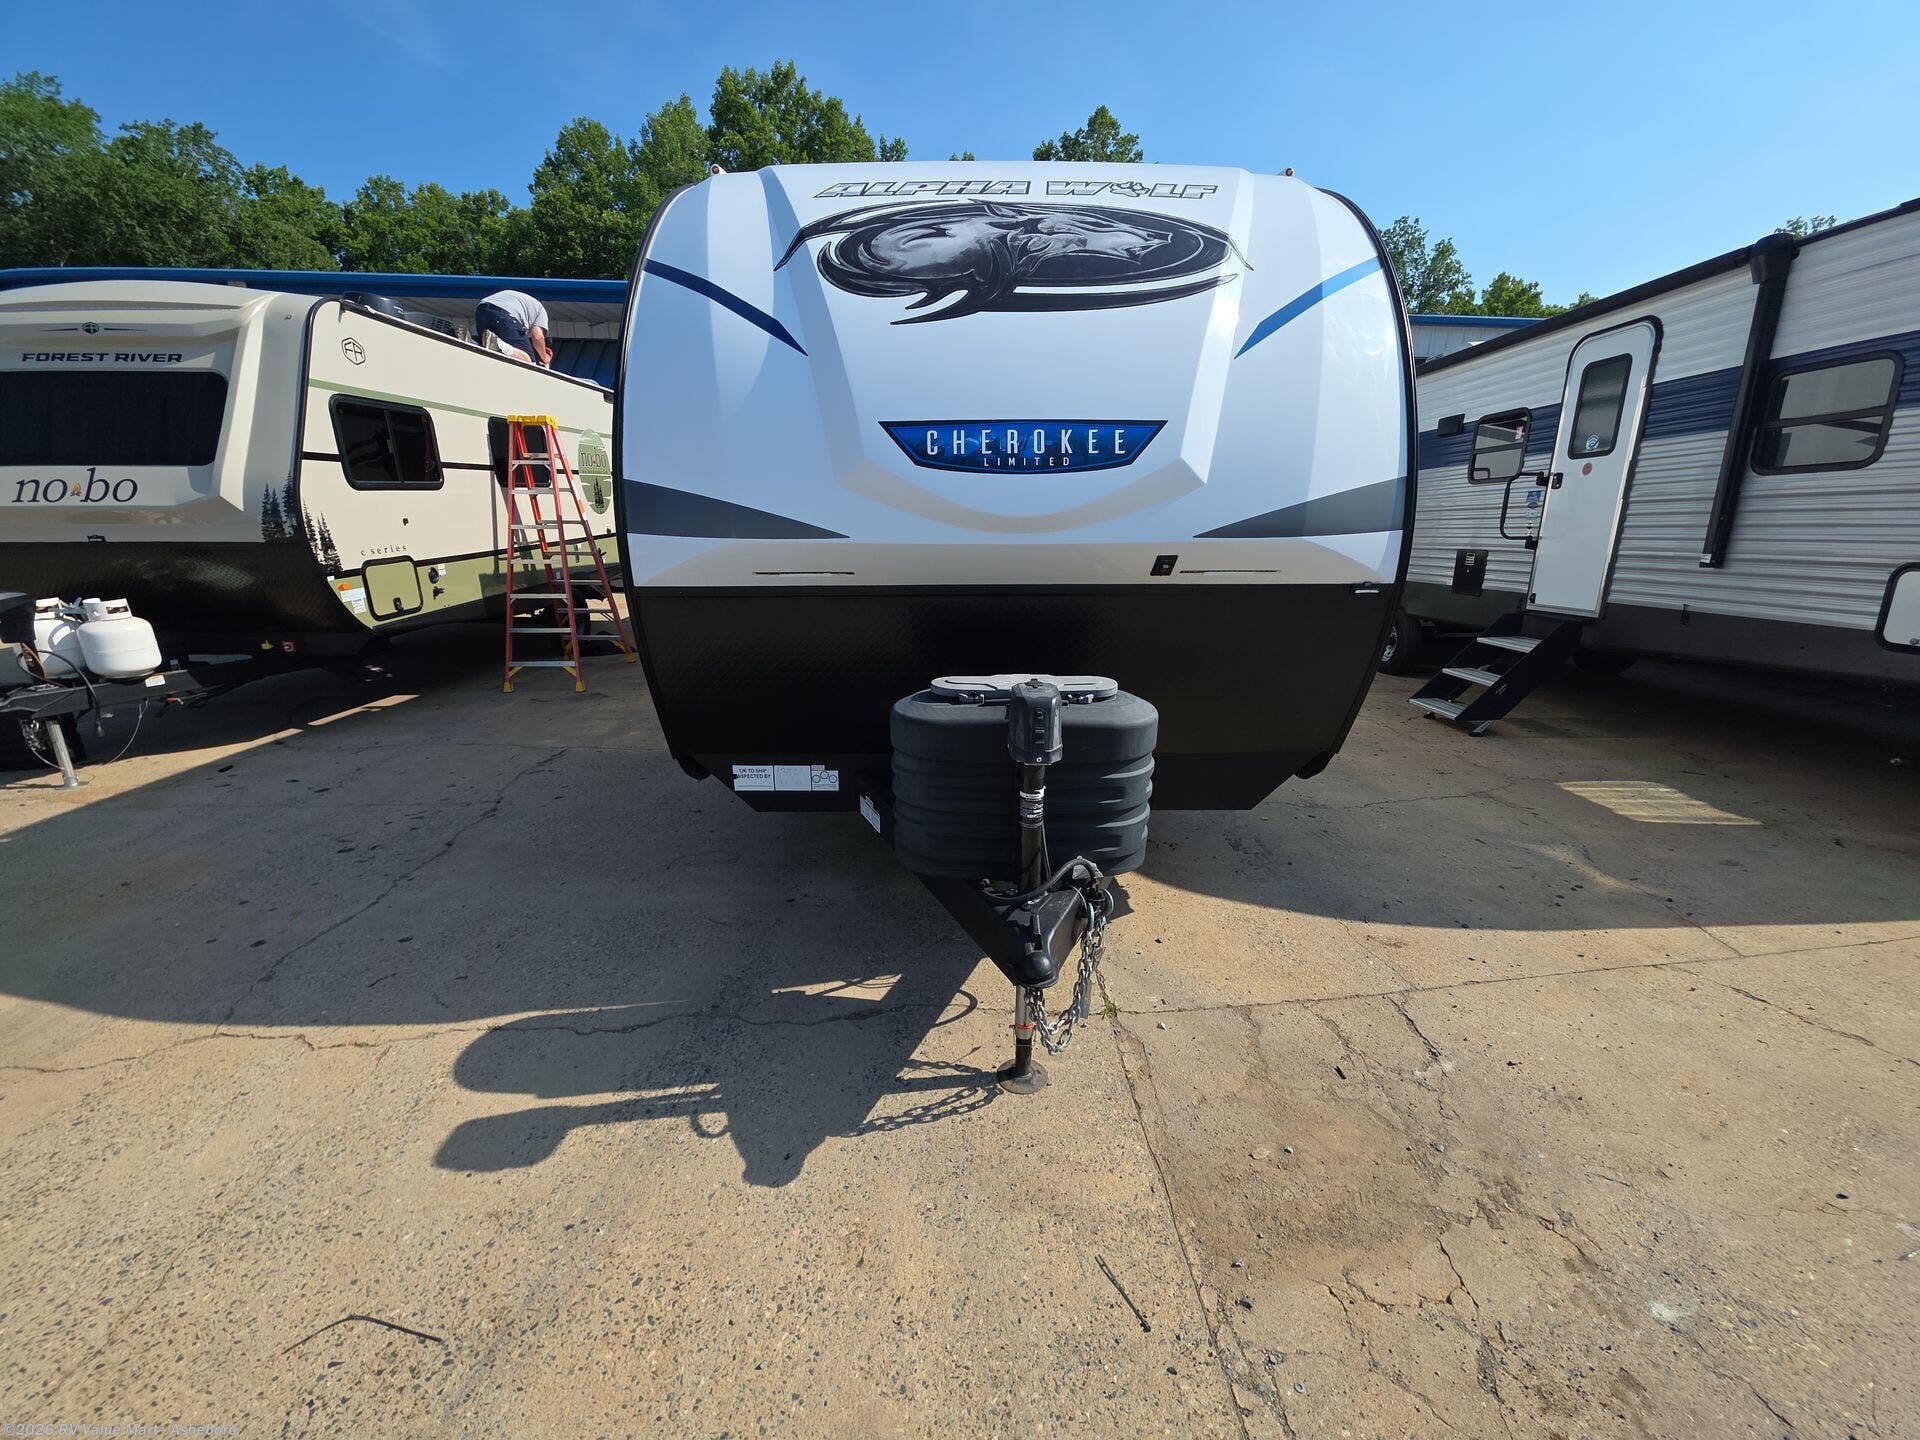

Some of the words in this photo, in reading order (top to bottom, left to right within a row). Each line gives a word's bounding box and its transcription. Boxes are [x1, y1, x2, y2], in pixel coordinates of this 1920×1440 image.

[813, 181, 1030, 197] ALPHA
[22, 352, 109, 362] FOREST
[114, 352, 183, 363] RIVER
[926, 429, 1126, 456] CHEROKEE
[984, 457, 1070, 466] LIMITED
[370, 544, 407, 555] series
